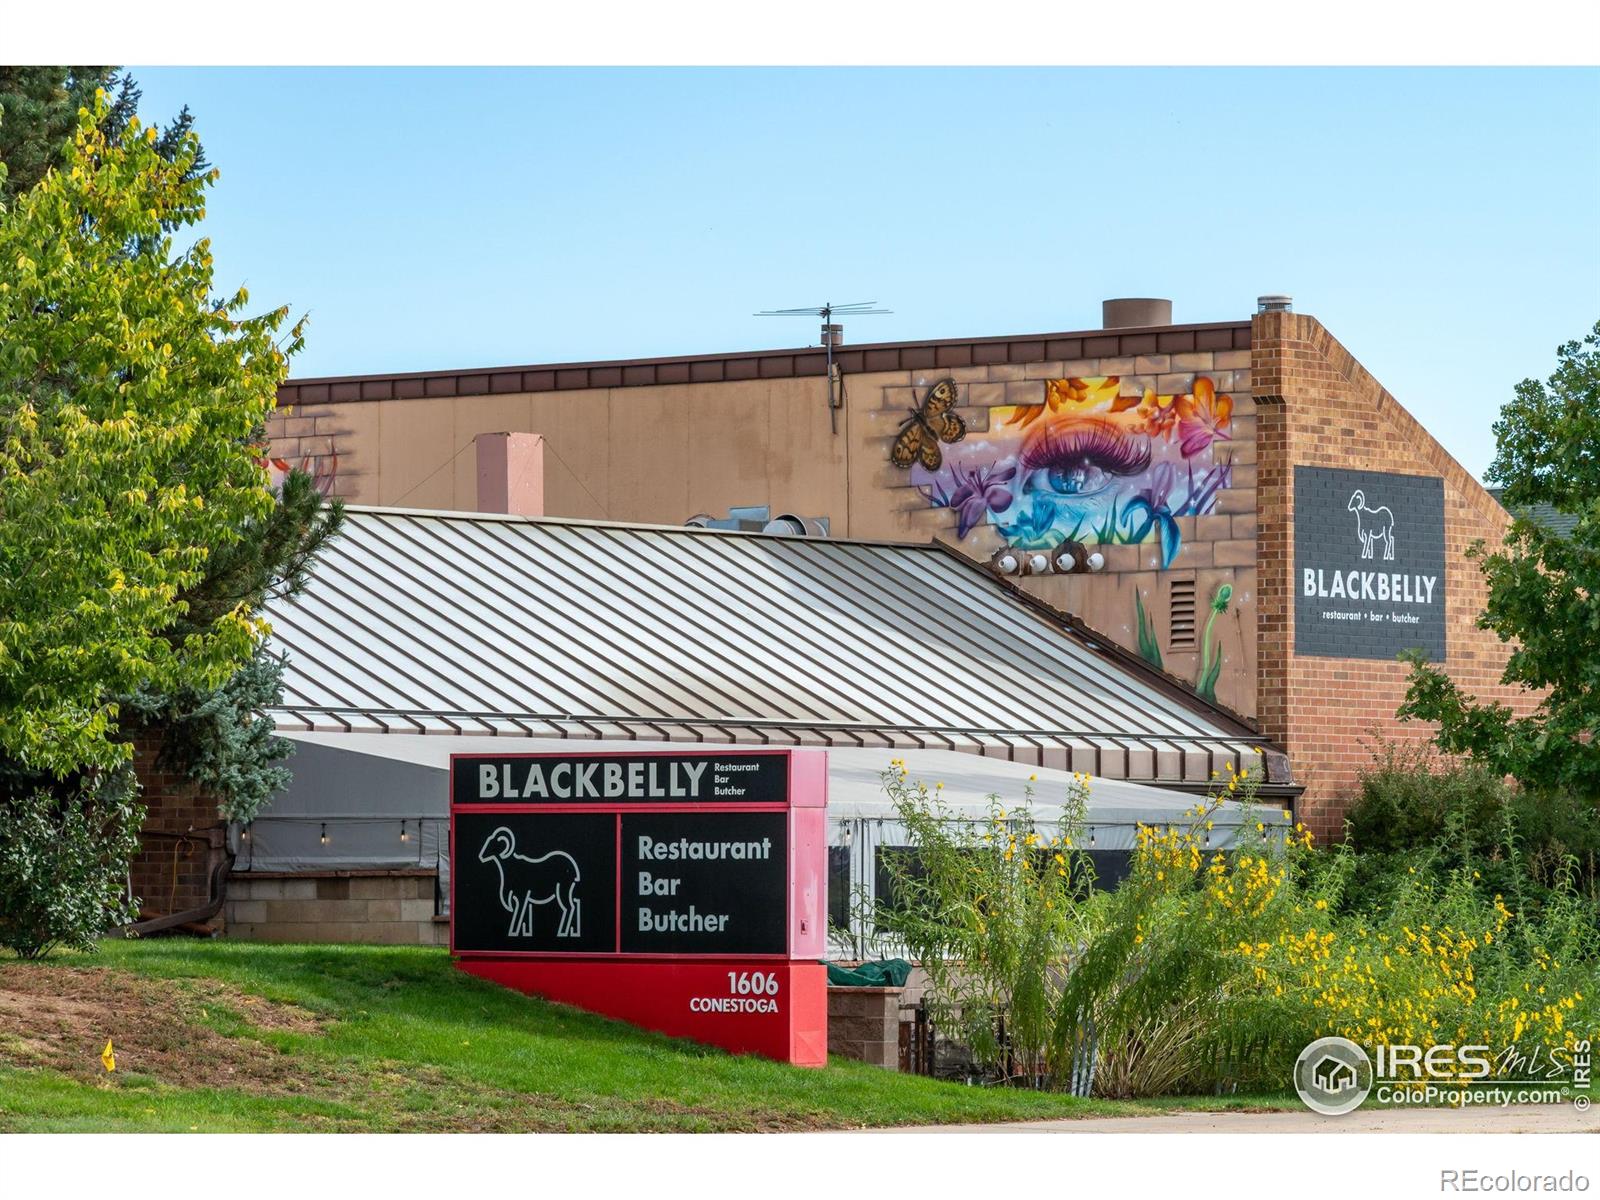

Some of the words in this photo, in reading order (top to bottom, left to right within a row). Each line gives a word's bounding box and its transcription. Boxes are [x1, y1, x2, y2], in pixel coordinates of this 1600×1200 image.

[1304, 568, 1437, 604] BLACKBELLY
[1322, 610, 1361, 621] restaurant
[1370, 611, 1383, 622] bar
[1392, 612, 1420, 624] butcher
[714, 762, 760, 772] Restaurant
[479, 762, 708, 798] BLACKBELLY
[714, 775, 729, 784] Bar
[714, 786, 746, 796] Butcher
[638, 836, 771, 860] Restaurant
[638, 871, 681, 896] Bar
[638, 905, 729, 932] Butcher
[727, 971, 779, 995] 1606
[690, 998, 779, 1013] CONESTOGA
